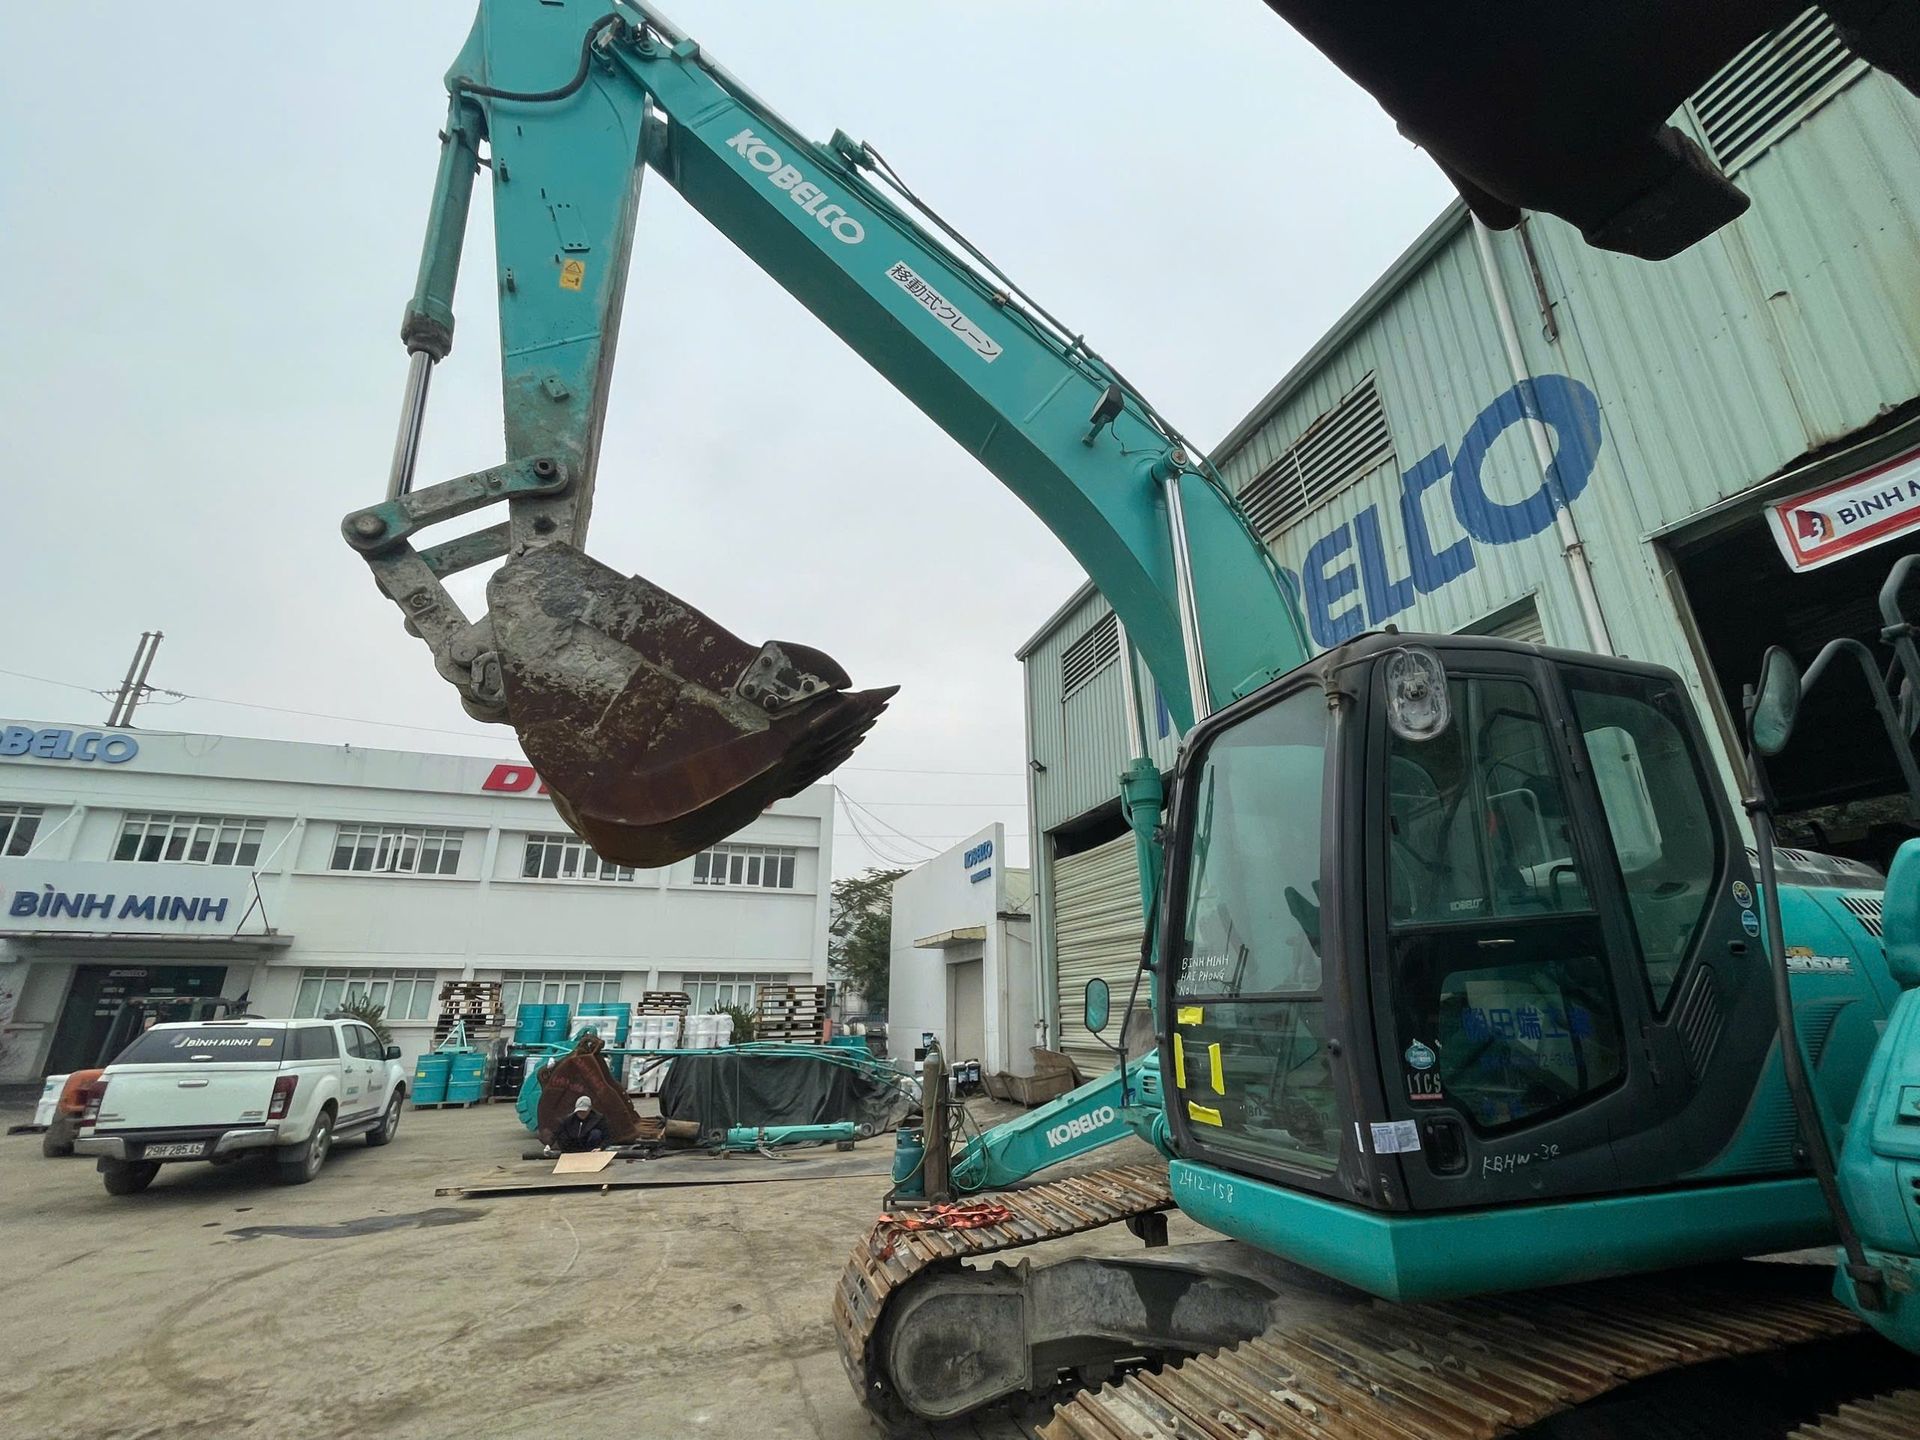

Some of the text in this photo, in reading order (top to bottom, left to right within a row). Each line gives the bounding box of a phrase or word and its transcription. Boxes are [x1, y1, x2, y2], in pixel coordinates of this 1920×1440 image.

[725, 128, 865, 244] KOBELCO
[890, 264, 998, 357] 移動式クレーン
[1272, 374, 1602, 649] ELCO
[1837, 486, 1905, 525] BÌNH
[0, 726, 139, 764] BELCO
[9, 884, 229, 922] BÌNH MINH
[1182, 957, 1205, 970] BINH
[218, 1038, 254, 1047] MINH
[1407, 1073, 1442, 1094] ITCS
[1046, 1105, 1115, 1148] KOBELCO
[1179, 1169, 1234, 1204] 2412-158
